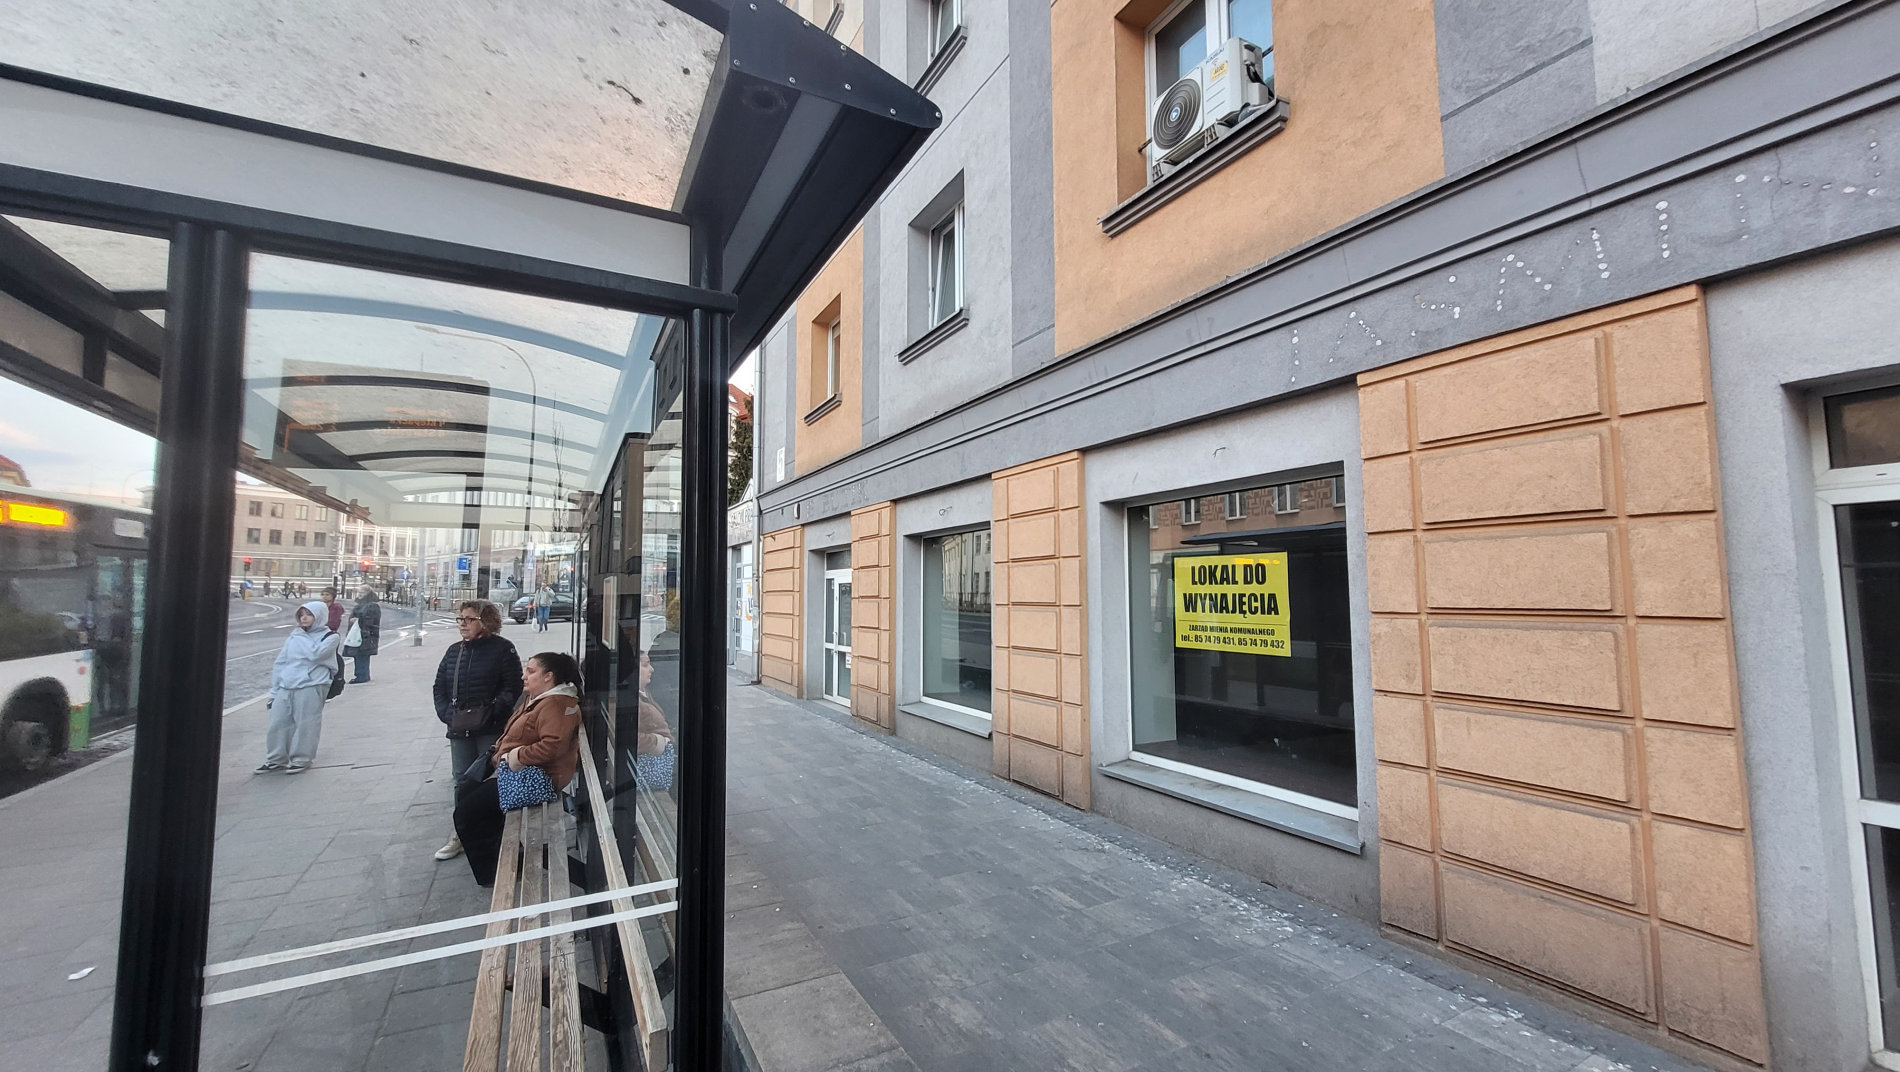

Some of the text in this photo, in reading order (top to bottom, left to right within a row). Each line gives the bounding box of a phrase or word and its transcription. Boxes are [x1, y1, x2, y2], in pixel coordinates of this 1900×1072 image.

[1191, 563, 1267, 585] LOKAL DO
[1183, 593, 1279, 618] WYNAJĘCIA
[1189, 624, 1275, 636] ZARZĄD MIENIA KOMUNALNEGO
[1181, 634, 1193, 642] tel.:
[1194, 635, 1203, 643] 85
[1204, 635, 1212, 643] 74
[1213, 635, 1220, 644] 79
[1238, 637, 1247, 646] 85
[1249, 638, 1257, 647] 74
[1259, 639, 1268, 647] 79
[1270, 640, 1284, 649] 432
